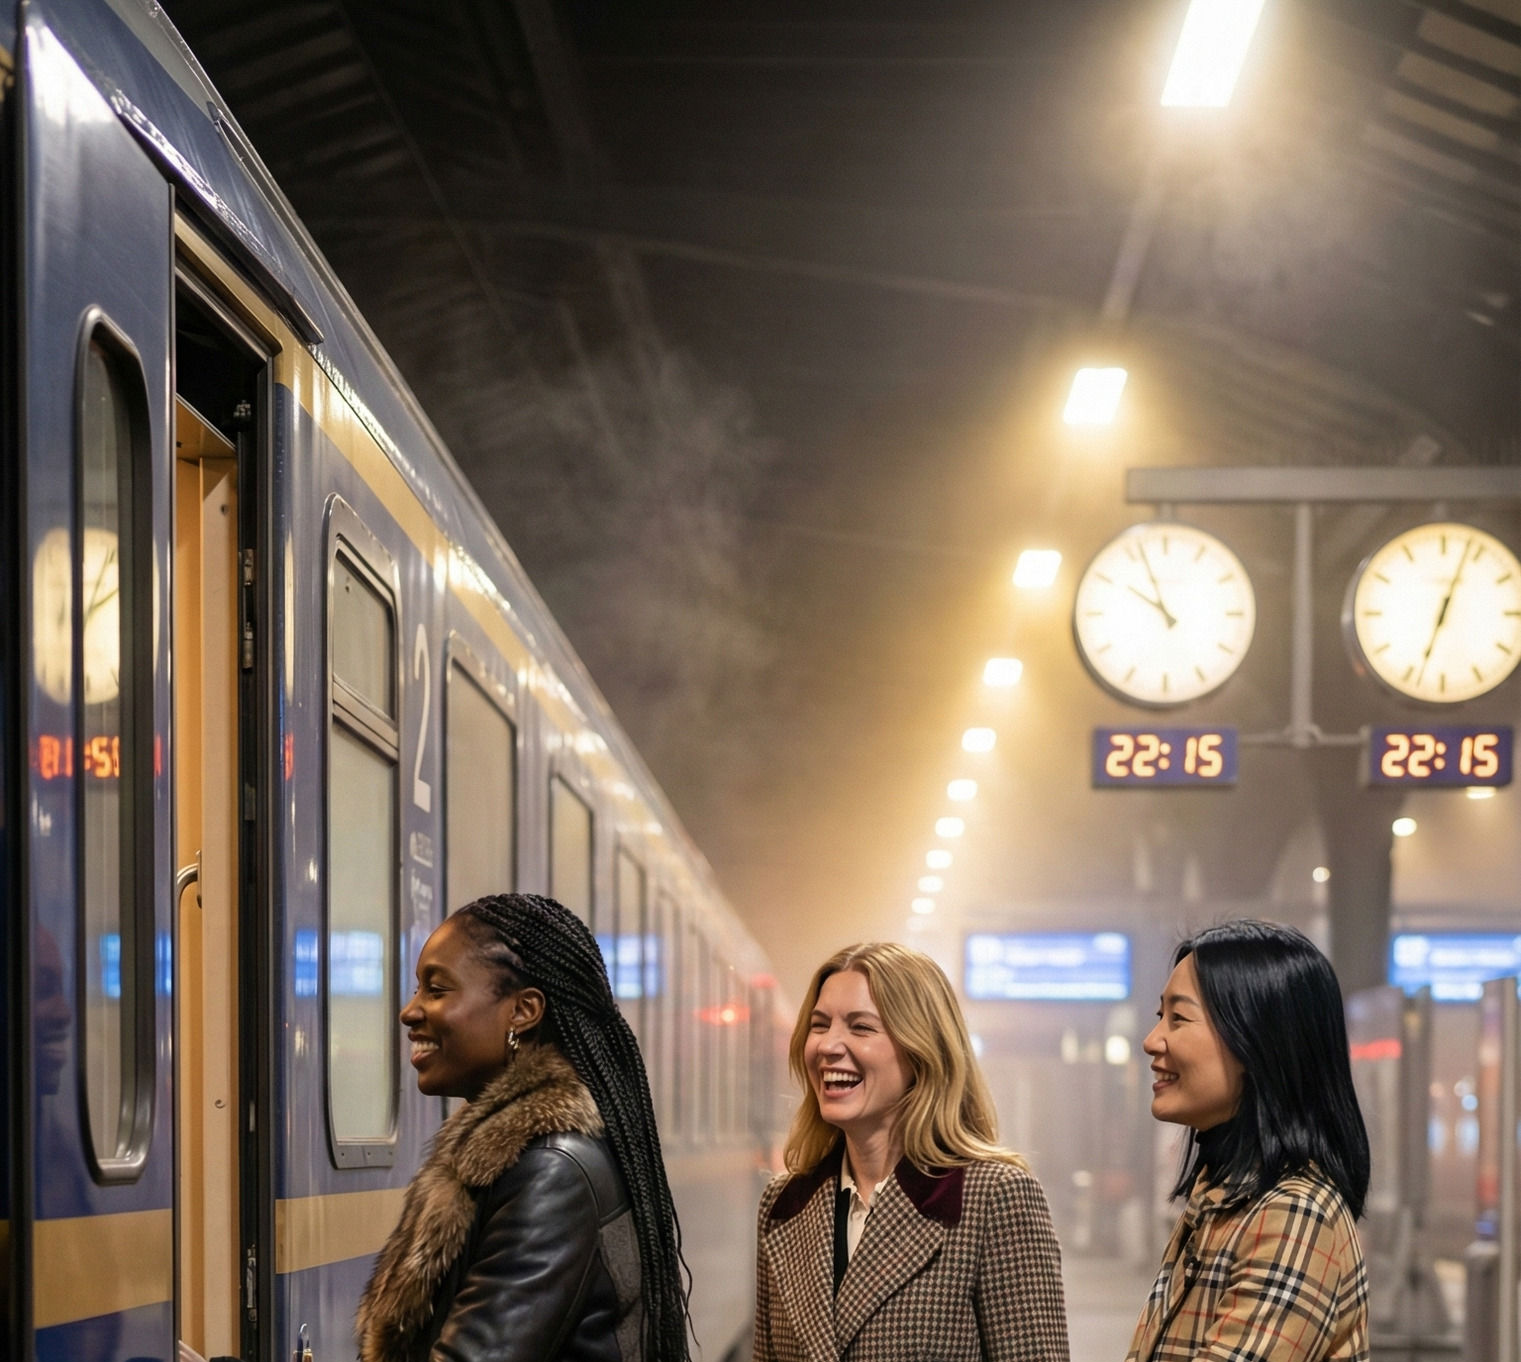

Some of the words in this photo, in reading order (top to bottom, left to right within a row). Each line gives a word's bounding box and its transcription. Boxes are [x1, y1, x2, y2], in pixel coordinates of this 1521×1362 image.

[413, 623, 432, 813] 2
[1105, 733, 1223, 778] 22:15
[1381, 733, 1499, 778] 22:15
